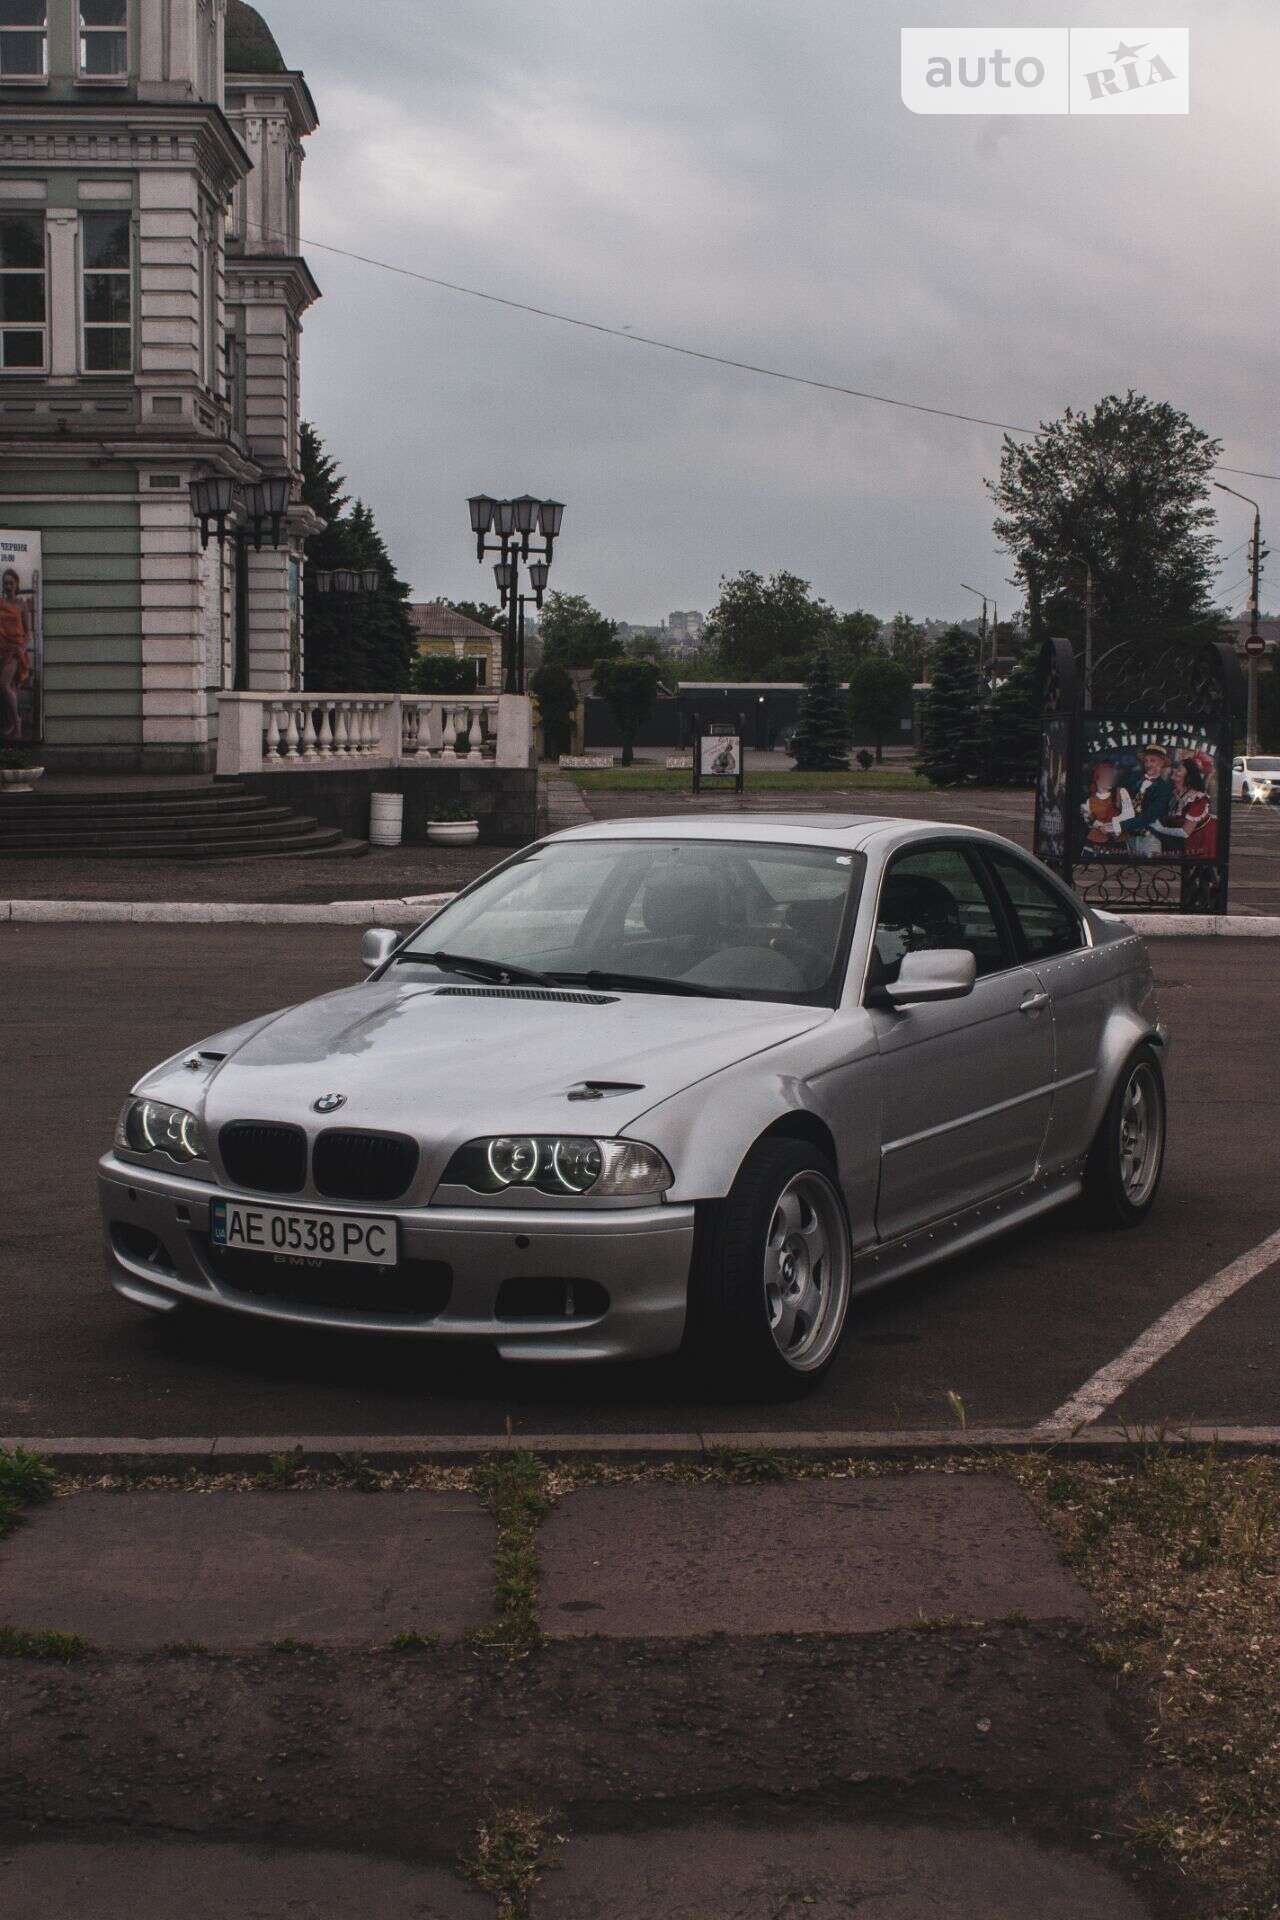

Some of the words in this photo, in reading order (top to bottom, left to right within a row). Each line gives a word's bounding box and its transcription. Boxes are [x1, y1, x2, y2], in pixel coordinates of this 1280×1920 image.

[229, 1211, 265, 1246] AE
[271, 1216, 335, 1253] 0538
[343, 1223, 386, 1257] PC
[273, 1255, 322, 1268] BMW
